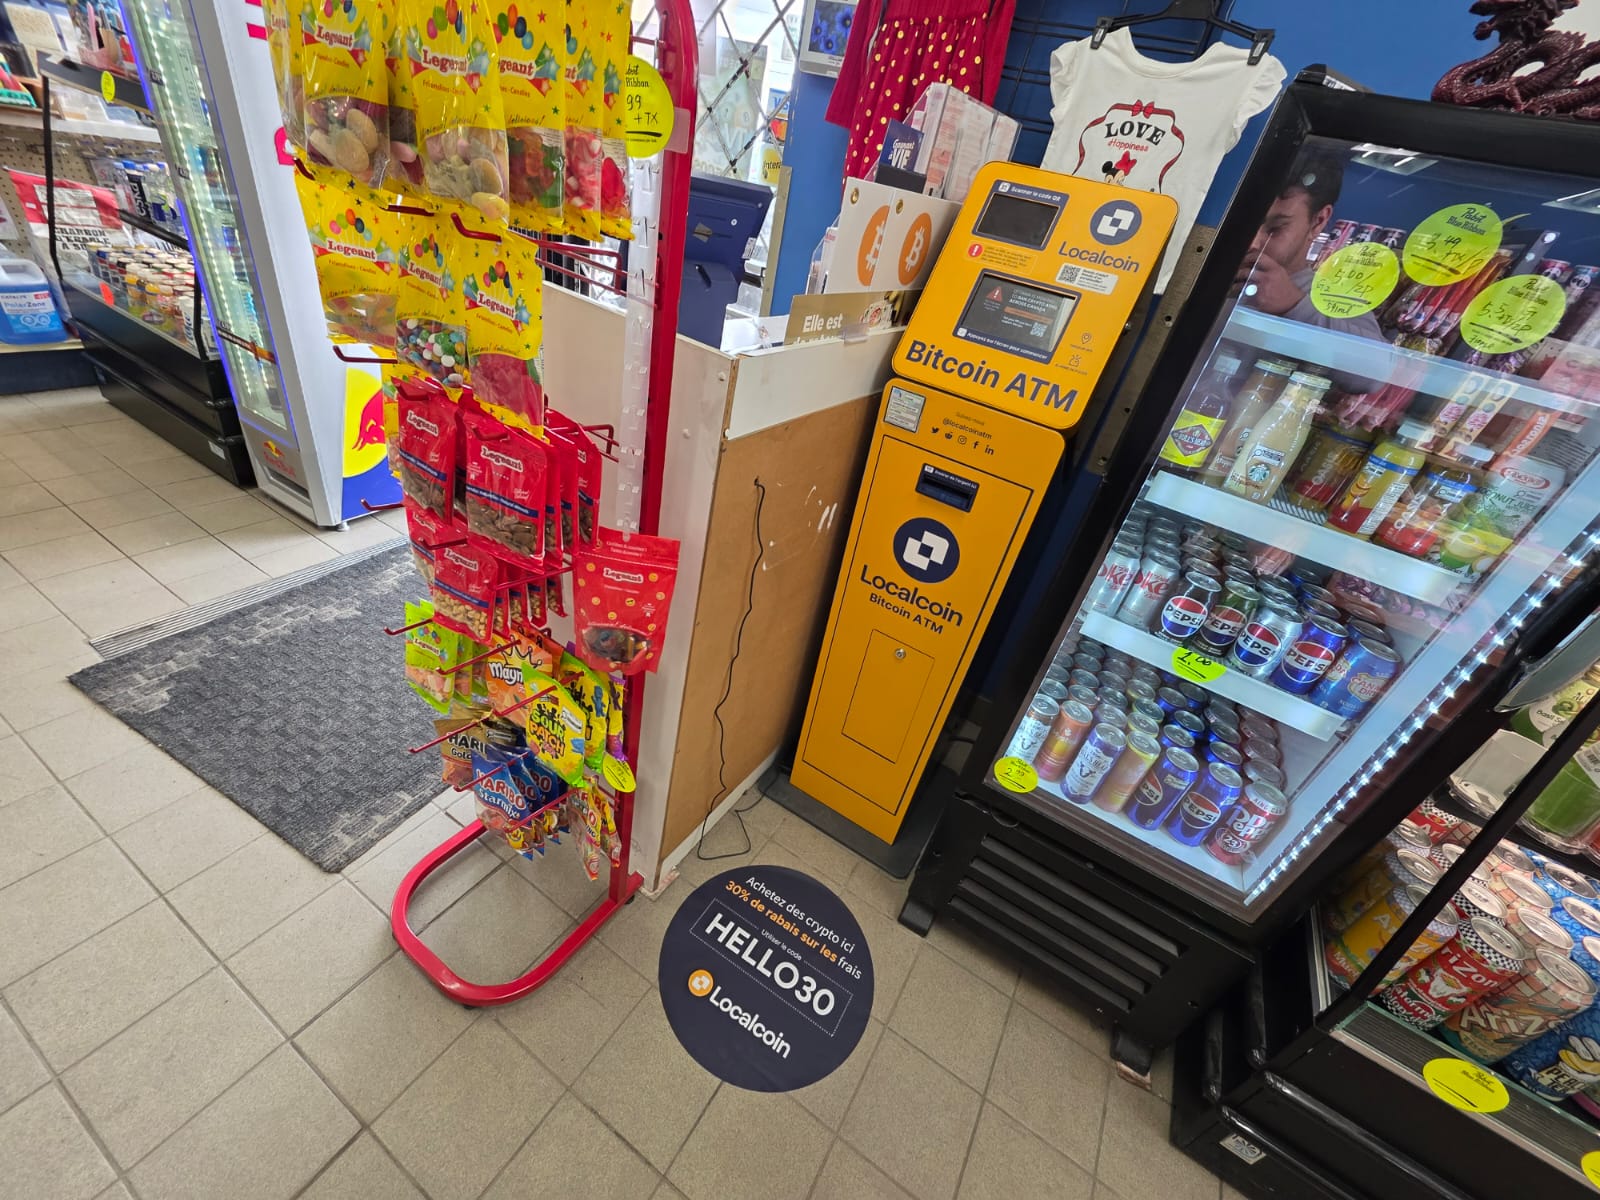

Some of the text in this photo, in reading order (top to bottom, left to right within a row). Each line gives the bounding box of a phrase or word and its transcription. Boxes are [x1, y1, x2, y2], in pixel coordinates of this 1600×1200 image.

[499, 60, 534, 76] geant
[1104, 120, 1166, 146] LOVE
[1107, 138, 1149, 152] Happiness
[1459, 207, 1487, 224] Pabst
[327, 239, 376, 260] Legeant
[1058, 240, 1140, 273] Localcoin
[410, 262, 442, 286] Legeant
[478, 292, 515, 318] Legeant
[803, 314, 843, 332] Elle est
[905, 340, 1079, 413] Bitcoin ATM
[407, 413, 439, 435] Legeant
[942, 417, 993, 440] @localcoinatm
[481, 446, 523, 473] Legeant
[445, 549, 478, 570] Legeant
[604, 569, 643, 584] Legeant
[860, 564, 964, 627] Localcoin
[869, 592, 944, 635] Bitcoin ATM
[1165, 605, 1201, 627] PEPSI
[1177, 651, 1213, 666] 1.00
[487, 662, 523, 686] Mayn
[529, 719, 566, 758] PATCH
[532, 709, 566, 743] SOUR
[446, 732, 488, 754] HARI
[476, 769, 526, 810] HARIBO
[1142, 782, 1159, 802] PSI
[479, 787, 519, 819] Starmix
[1184, 796, 1218, 823] PEPSI
[745, 876, 856, 954] Achetez des crypto ici
[725, 880, 863, 981] 30% de rabais sur les frais
[761, 929, 803, 961] Utiliser le code
[704, 912, 836, 1017] HELLO30
[709, 985, 792, 1060] Localcoin
